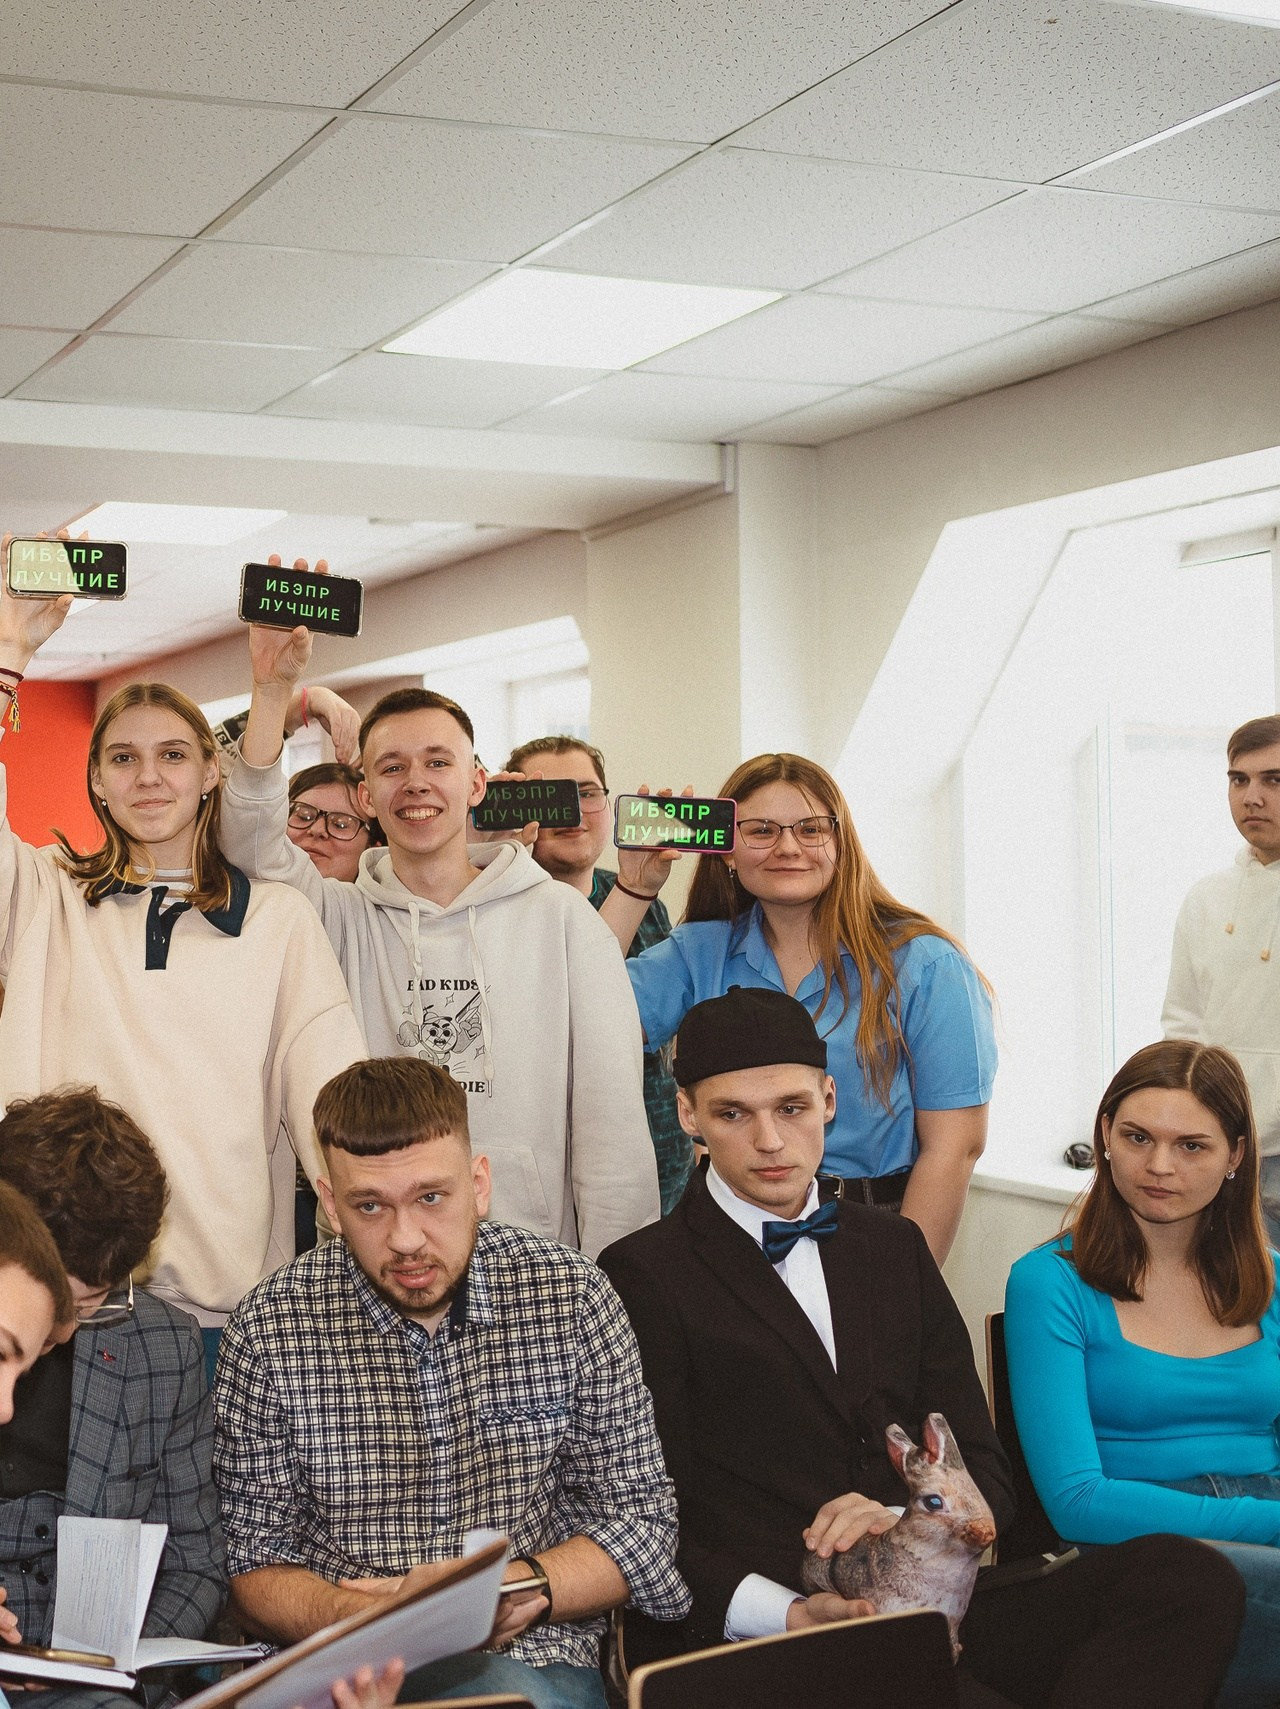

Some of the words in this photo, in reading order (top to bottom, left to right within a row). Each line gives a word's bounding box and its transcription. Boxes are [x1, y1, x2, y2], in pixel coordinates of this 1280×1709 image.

[22, 547, 104, 564] ИБЭПР
[14, 570, 119, 589] ЛУЧШИЕ
[266, 579, 330, 599] ИБЭПР
[259, 598, 341, 621] ЛУЧШИЕ
[486, 785, 556, 801] ИБЭПР
[483, 806, 573, 822] ЛУЧШИЕ
[630, 801, 711, 820] ИБЭПР
[623, 825, 725, 845] ЛУЧШИЕ
[440, 979, 480, 991] KIDS
